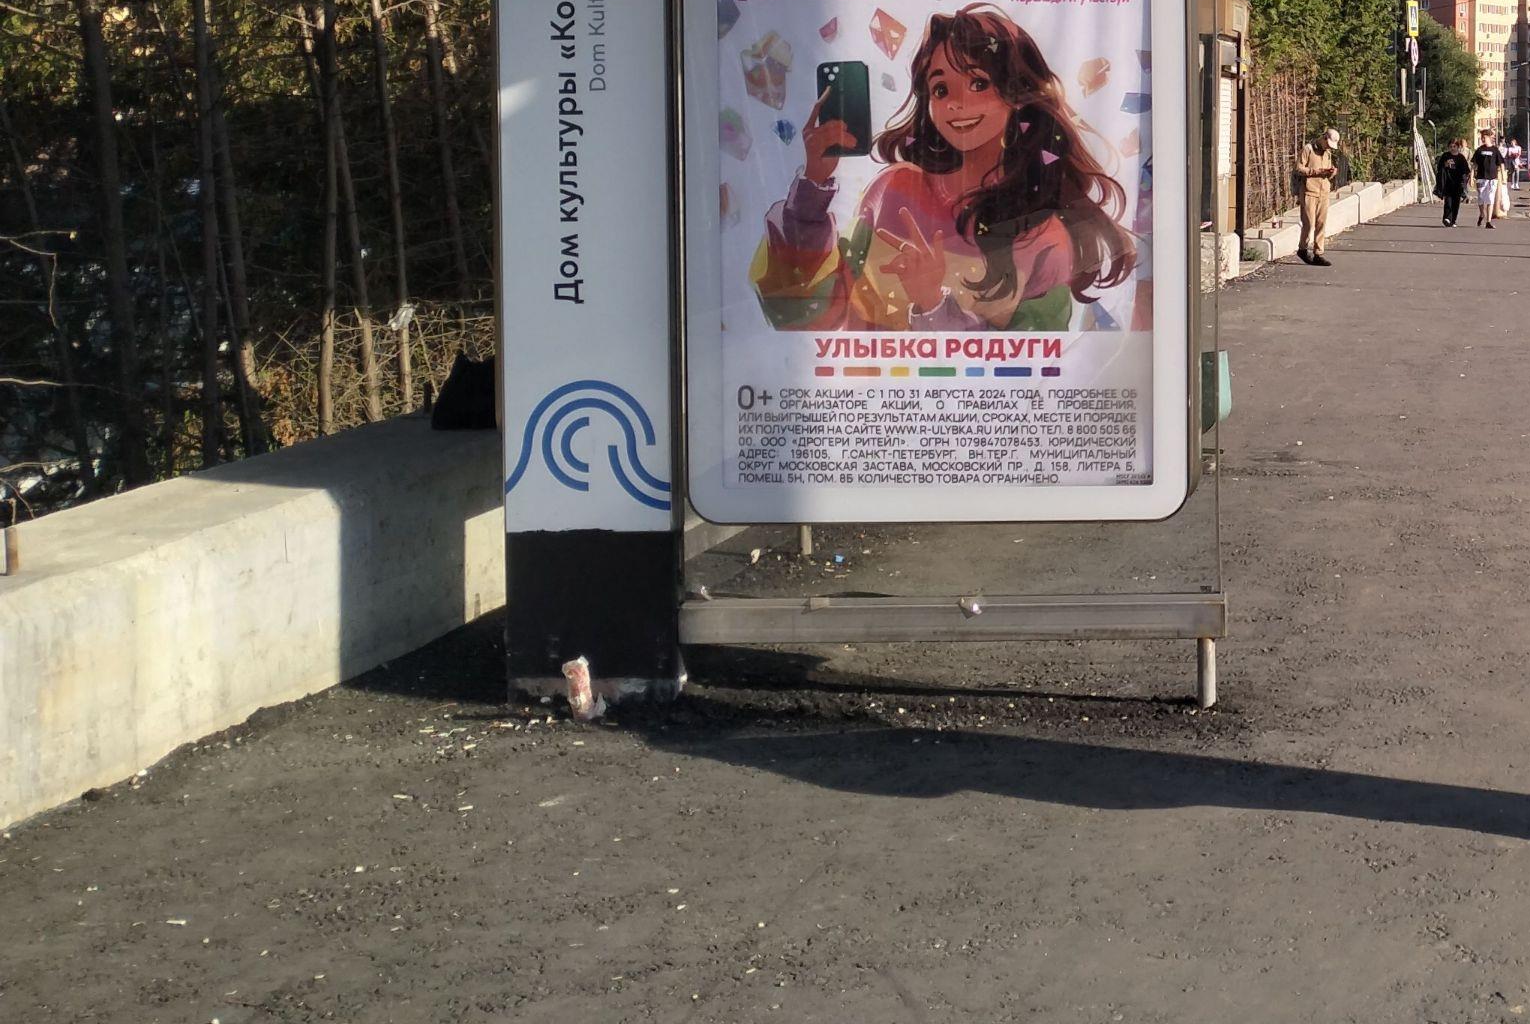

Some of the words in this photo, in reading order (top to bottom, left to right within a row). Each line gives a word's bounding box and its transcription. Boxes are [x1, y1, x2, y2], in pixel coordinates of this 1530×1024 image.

[588, 44, 606, 92] Dom
[558, 72, 584, 222] культуры
[554, 233, 584, 305] Дом
[737, 384, 773, 410] 0+
[779, 389, 811, 399] СРОК
[814, 389, 854, 400] АКЦИИ
[866, 389, 876, 399] С
[880, 389, 884, 399] 1
[888, 389, 905, 399] ПО
[909, 389, 920, 399] 31
[924, 389, 975, 399] АВГУСТА
[979, 389, 1006, 399] 2024
[1048, 389, 1117, 400] ПОДРОБНЕЕ
[1121, 389, 1137, 399] ОБ
[779, 400, 868, 410] ОРГАНИЗАТОРЕ
[881, 400, 923, 411] АКЦИИ,
[935, 400, 945, 410] О
[957, 400, 1018, 410] ПРАВИЛАХ
[738, 412, 762, 423] ИЛИ
[764, 411, 837, 423] ВЫИГРЫШЕЙ
[838, 412, 855, 423] ПО
[857, 412, 936, 423] РЕЗУЛЬТАТАМ
[982, 412, 1031, 423] СРОКАХ,
[1033, 412, 1073, 423] МЕСТЕ
[1074, 412, 1082, 423] И
[1084, 412, 1137, 423] ПОРЯДКЕ
[738, 425, 754, 435] ИХ
[755, 425, 825, 435] ПОЛУЧЕНИЯ
[827, 425, 842, 435] НА
[844, 423, 882, 435] САЙТЕ
[884, 425, 991, 435] WWW.R-ULYBKA.RU
[994, 425, 1019, 435] ИЛИ
[1020, 425, 1038, 435] ПО
[1066, 425, 1074, 435] 8
[1076, 425, 1097, 435] 800
[1099, 425, 1120, 435] 505
[1122, 425, 1137, 435] 66
[760, 437, 787, 446] ООО
[792, 437, 850, 447] «ДРОГЕРИ
[919, 437, 950, 446] ОГРН
[1048, 435, 1136, 447] ЮРИДИЧЕСКИЙ
[1030, 447, 1136, 461] МУНИЦИПАЛЬНЫЙ
[738, 461, 776, 471] ОКРУГ
[778, 461, 858, 471] МОСКОВСКАЯ
[862, 461, 917, 472] ЗАСТАВА,
[922, 459, 1003, 471] МОСКОВСКИЙ
[1076, 461, 1120, 471] ЛИТЕРА
[839, 473, 854, 483] 8Б
[857, 473, 934, 483] КОЛИЧЕСТВО
[935, 473, 980, 483] ТОВАРА
[982, 473, 1061, 483] ОГРАНИЧЕНО.
